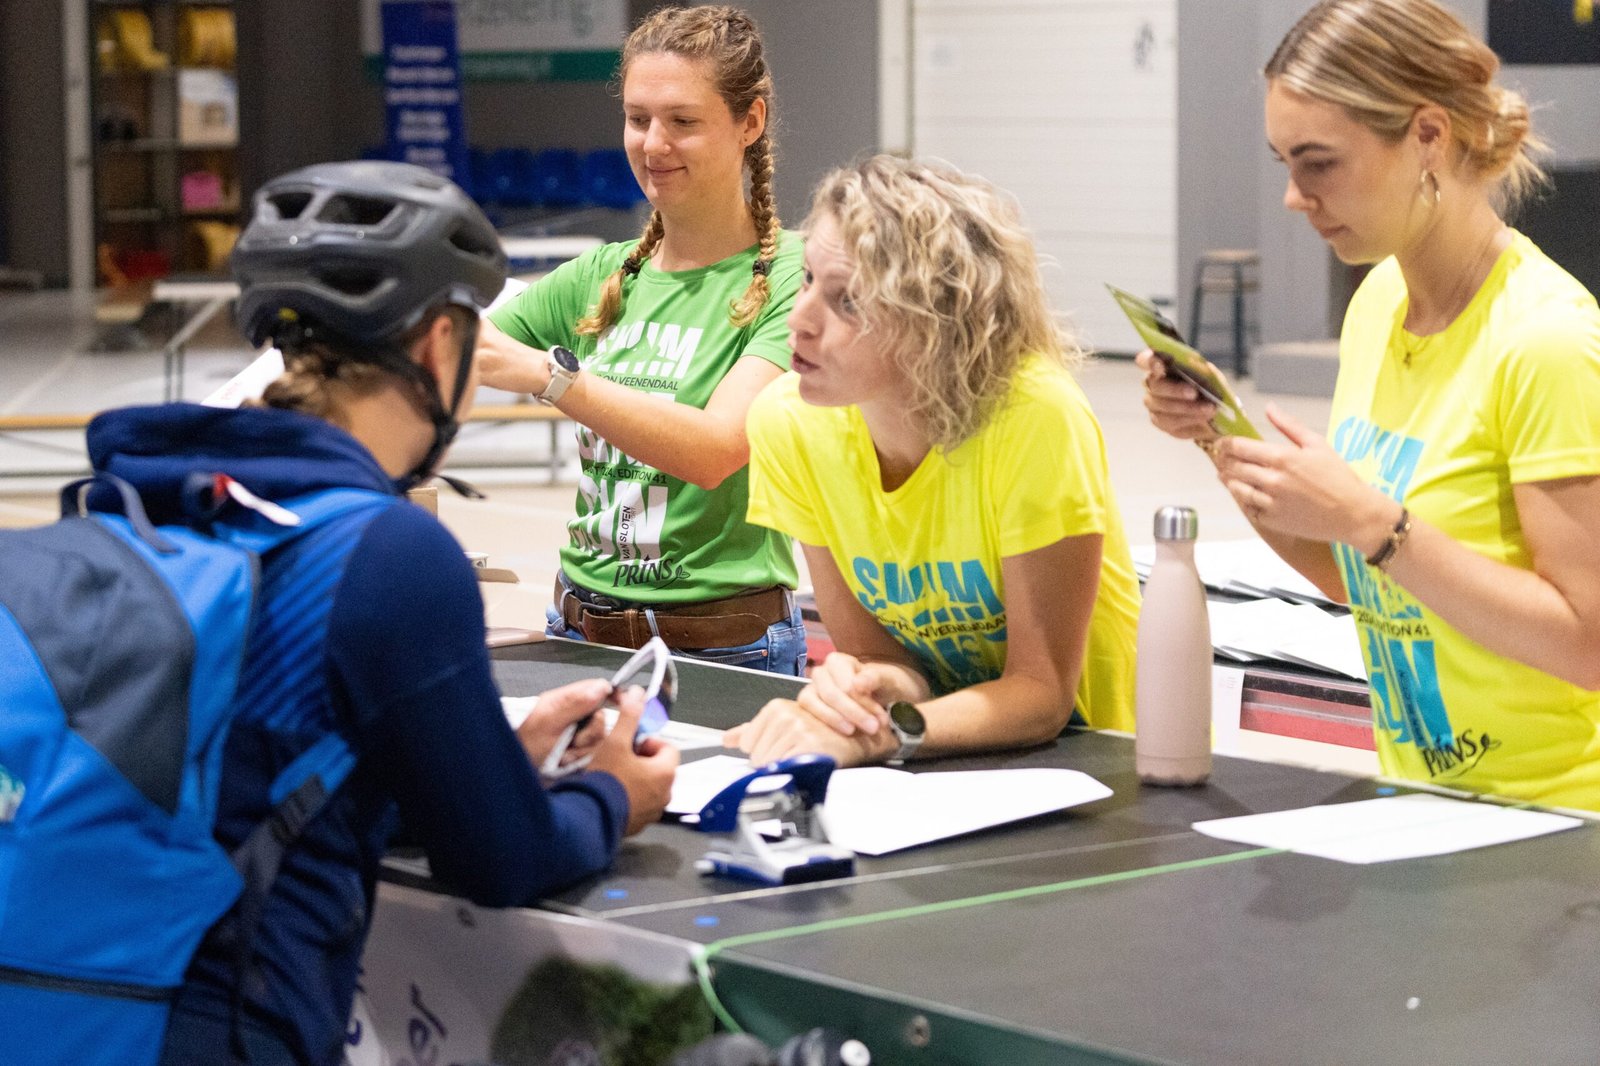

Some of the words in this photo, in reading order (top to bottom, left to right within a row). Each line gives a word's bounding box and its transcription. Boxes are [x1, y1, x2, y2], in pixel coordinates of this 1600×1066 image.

[619, 376, 679, 391] VEENENDAAL
[652, 473, 668, 484] 41
[619, 505, 631, 543] SLOTEN
[620, 543, 631, 560] VAN
[612, 554, 674, 588] PRINS
[852, 556, 1006, 624] SWIM
